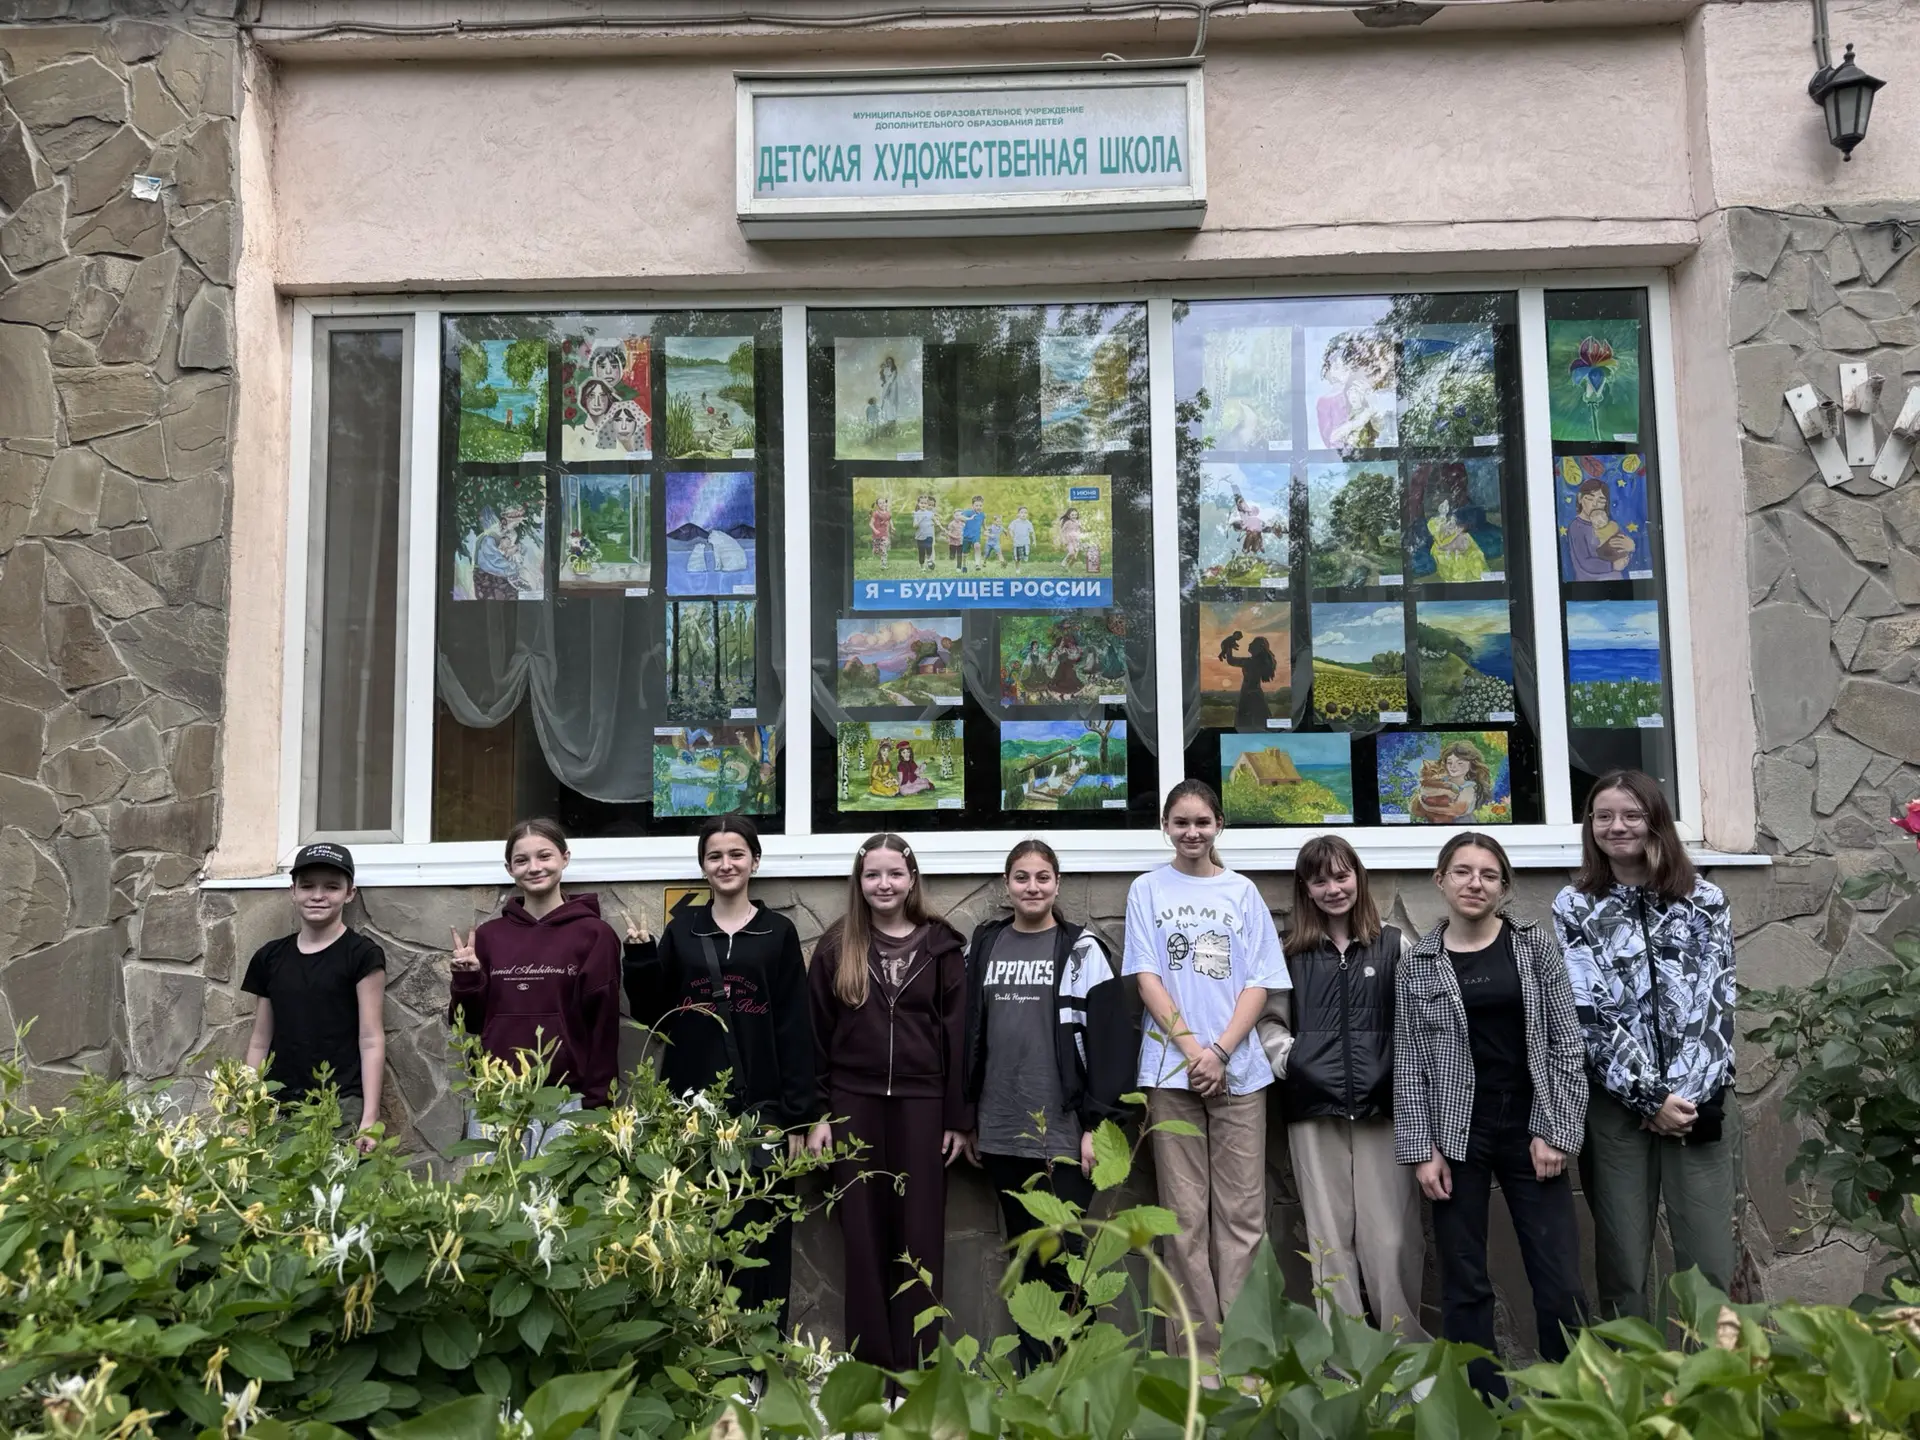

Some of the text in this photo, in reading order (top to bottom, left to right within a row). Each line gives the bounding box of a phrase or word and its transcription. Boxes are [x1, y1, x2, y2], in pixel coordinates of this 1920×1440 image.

[853, 106, 1084, 120] МУНИЦИПАЛЬНОЕ ОБРАЗОВАТЕЛЬНОЕ УЧРЕЖДЕНИЕ
[875, 117, 1064, 131] ДОПОЛНИТЕЛЬНОГО ОБРАЗОВАНИЯ ДЕТЕЙ
[758, 135, 1182, 192] ДЕТСКАЯ ХУДОЖЕСТВЕННАЯ ШКОЛА
[865, 582, 879, 599] Я
[899, 581, 1004, 601] БУДУЩЕЕ
[1010, 580, 1101, 597] РОССИИ
[515, 963, 565, 975] Ambitions
[983, 960, 1054, 986] APPINES
[736, 998, 769, 1015] Rich
